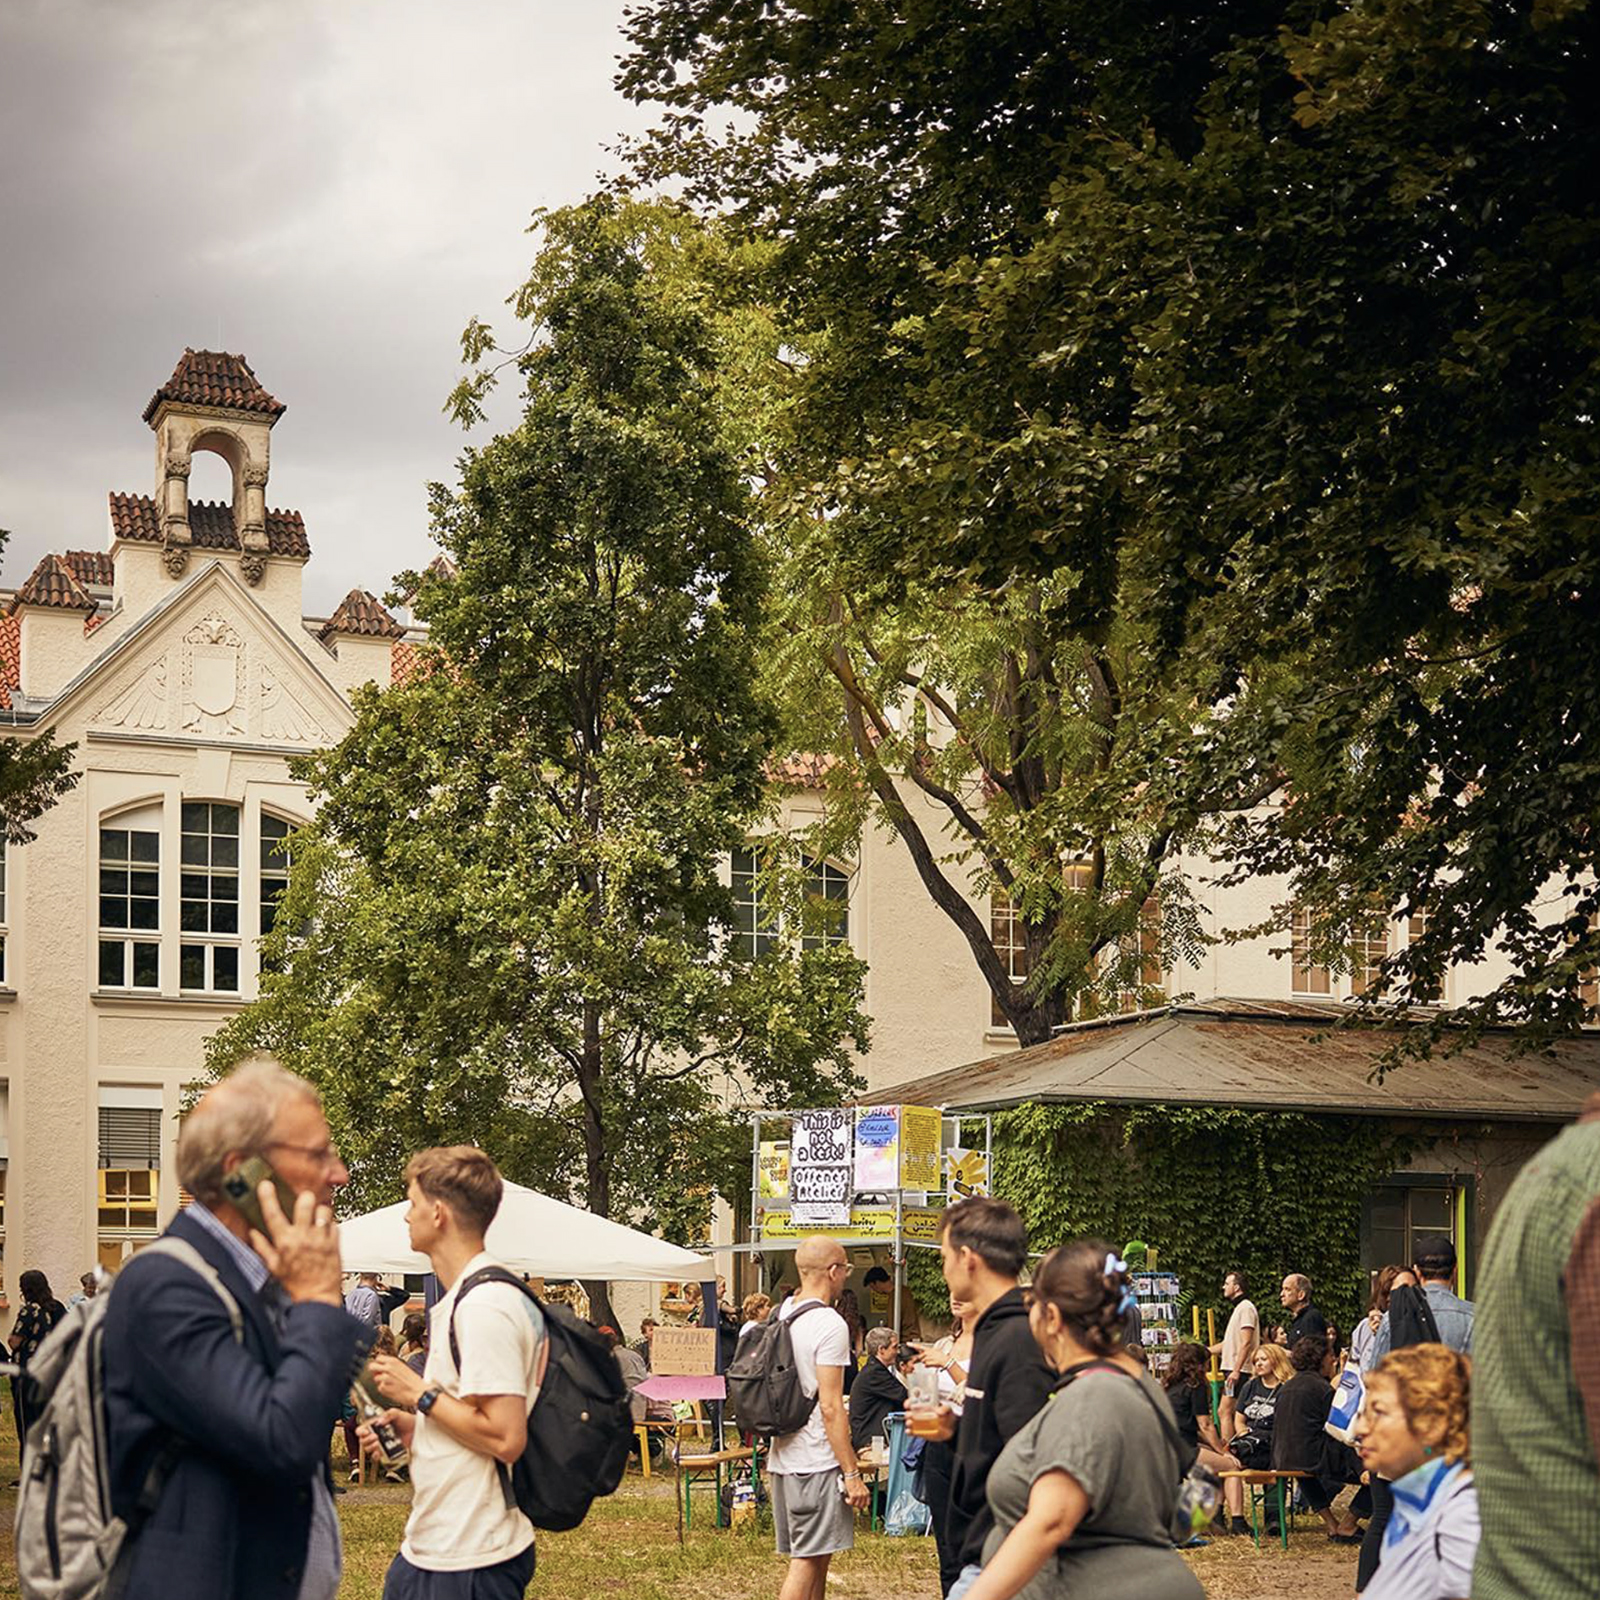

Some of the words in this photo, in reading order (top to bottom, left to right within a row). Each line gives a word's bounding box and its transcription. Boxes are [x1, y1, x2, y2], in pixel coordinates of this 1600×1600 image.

[802, 1113, 829, 1130] This
[831, 1110, 844, 1130] is
[809, 1129, 833, 1146] not
[798, 1146, 809, 1161] a
[810, 1142, 845, 1161] test!
[800, 1185, 843, 1198] Atelier
